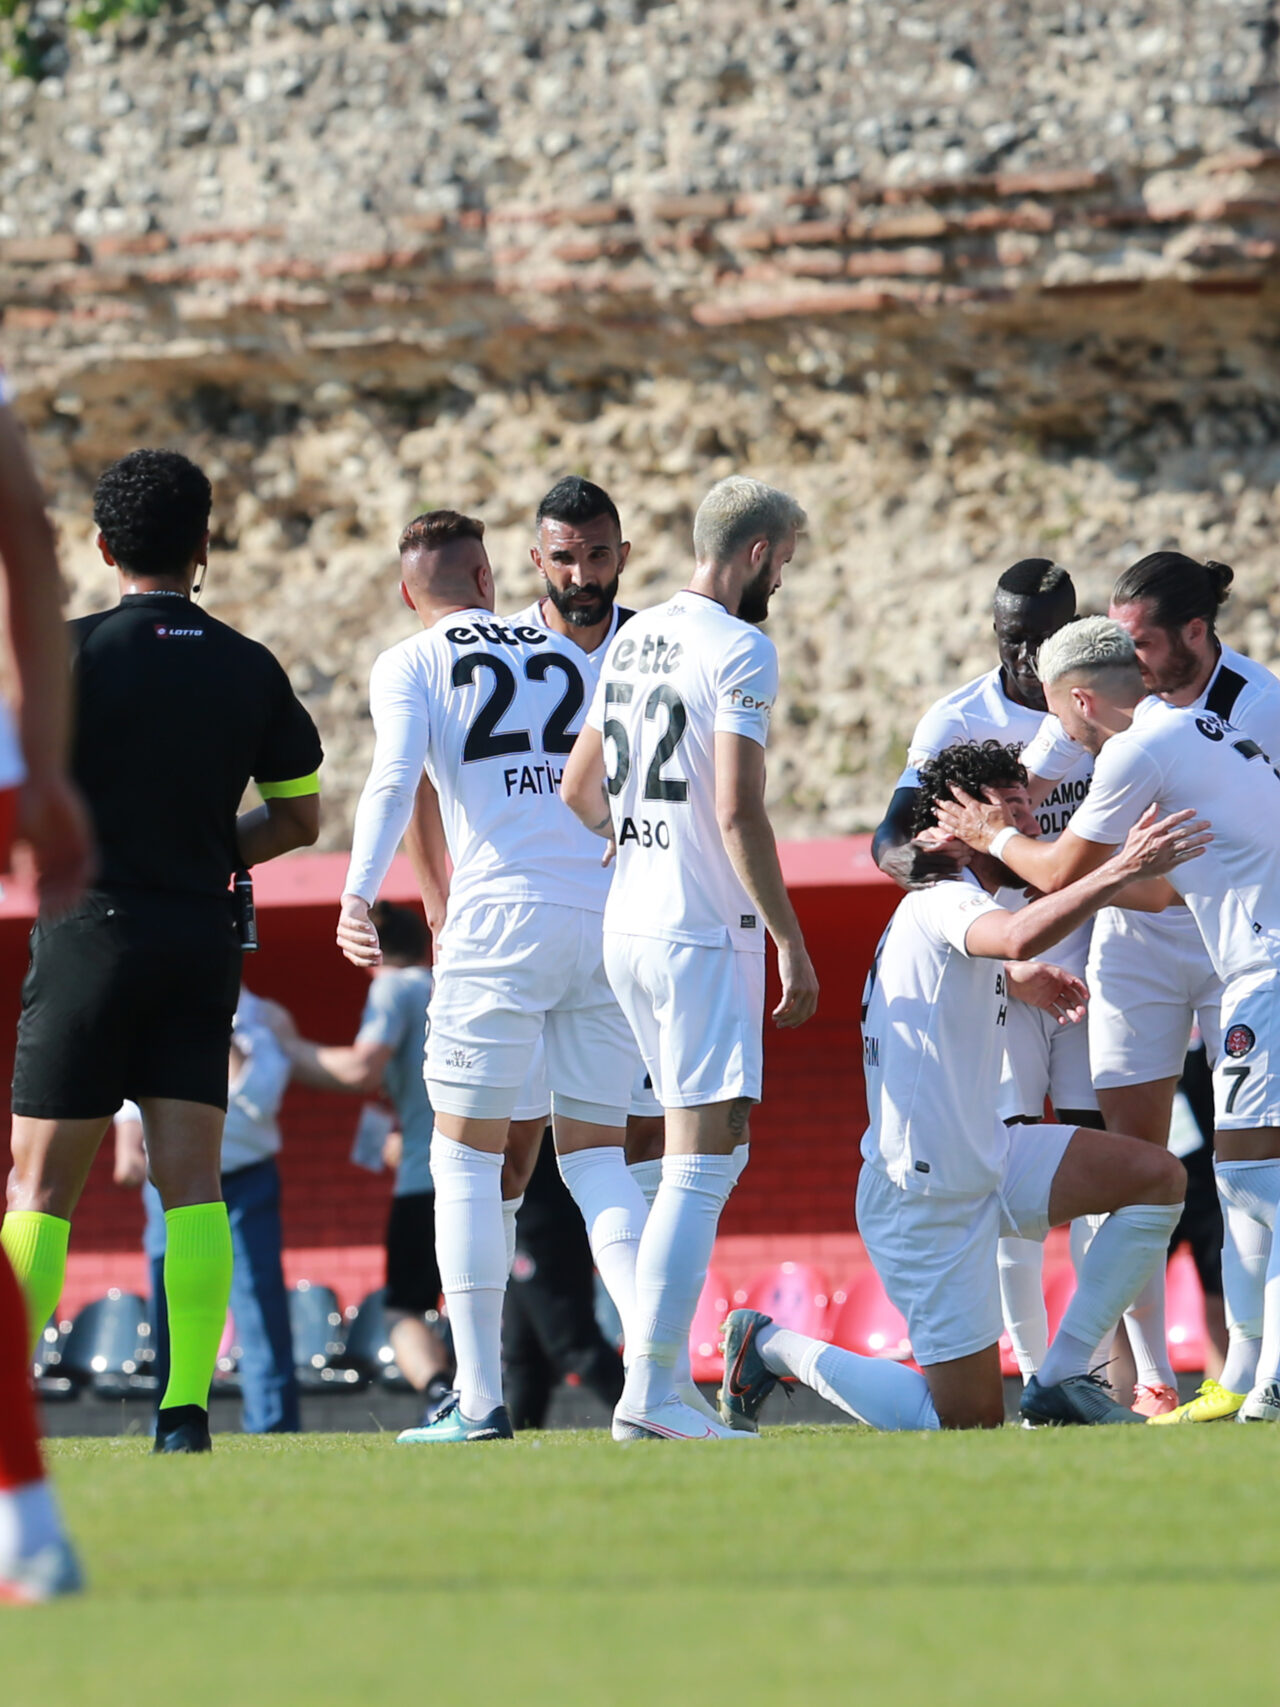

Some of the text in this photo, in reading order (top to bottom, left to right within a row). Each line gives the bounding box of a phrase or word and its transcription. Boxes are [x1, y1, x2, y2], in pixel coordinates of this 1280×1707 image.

[168, 628, 204, 637] LOTTO
[445, 623, 548, 646] ette
[611, 634, 684, 674] ette
[452, 651, 585, 766] 22
[603, 680, 690, 804] 52
[618, 816, 670, 850] ABO
[1222, 1066, 1251, 1114] 7
